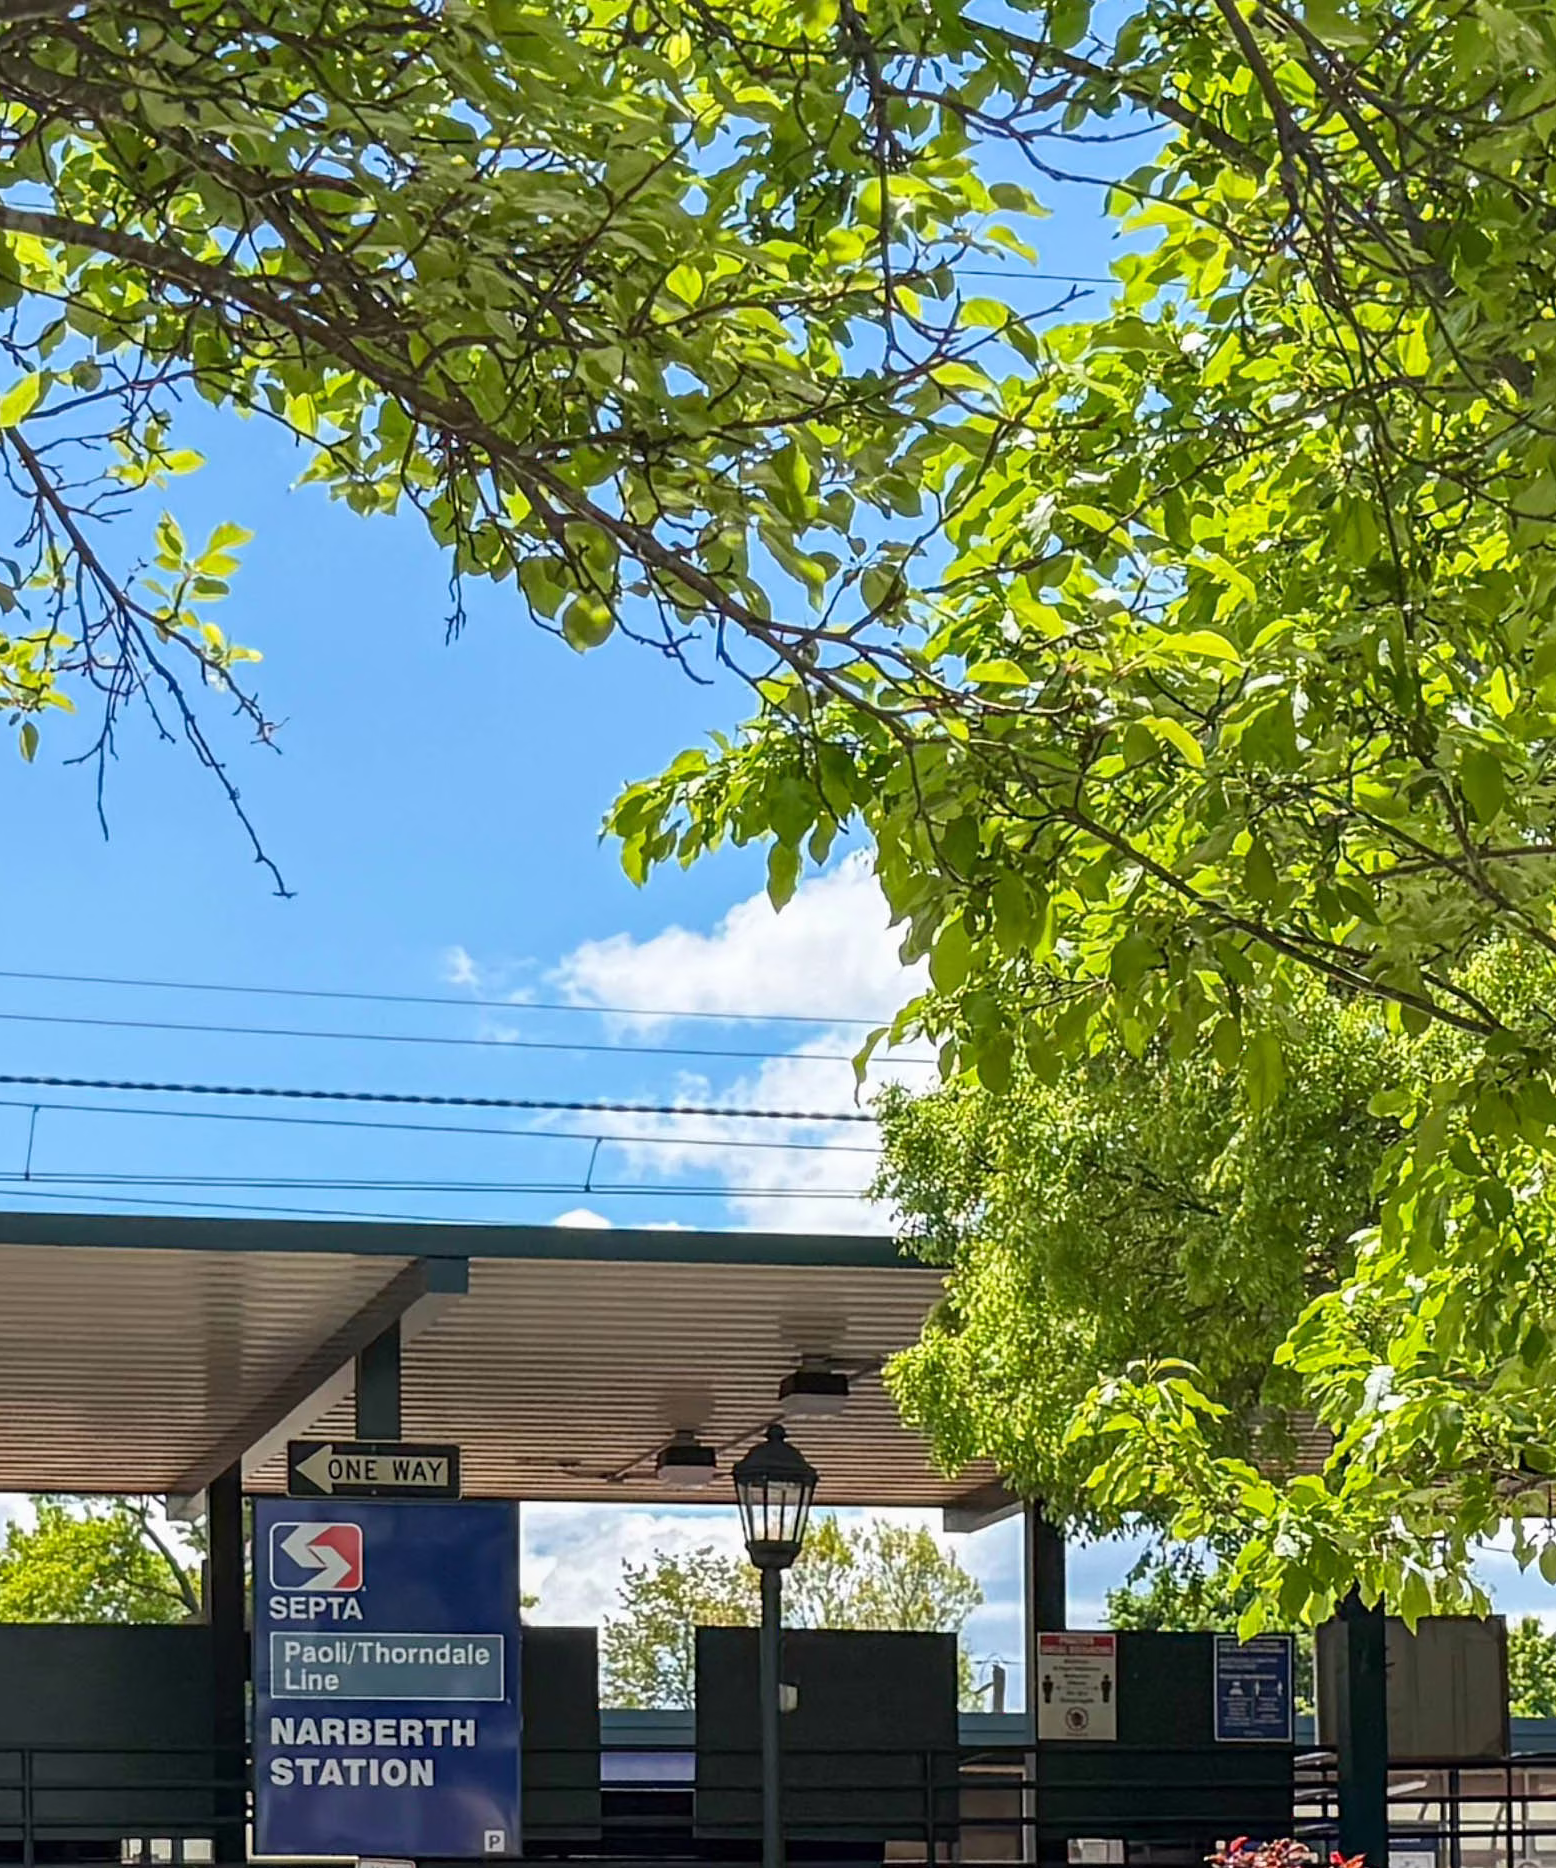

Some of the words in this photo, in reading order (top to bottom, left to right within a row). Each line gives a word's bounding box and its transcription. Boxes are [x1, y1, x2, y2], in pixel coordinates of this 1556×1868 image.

[328, 1458, 378, 1481] ONE
[392, 1459, 443, 1483] WAY
[269, 1596, 364, 1621] SEPTA
[284, 1640, 491, 1666] Paoli/Thorndale
[285, 1668, 340, 1691] Line
[271, 1717, 476, 1747] NARBERTH
[270, 1757, 435, 1787] STATION
[489, 1835, 501, 1848] P
